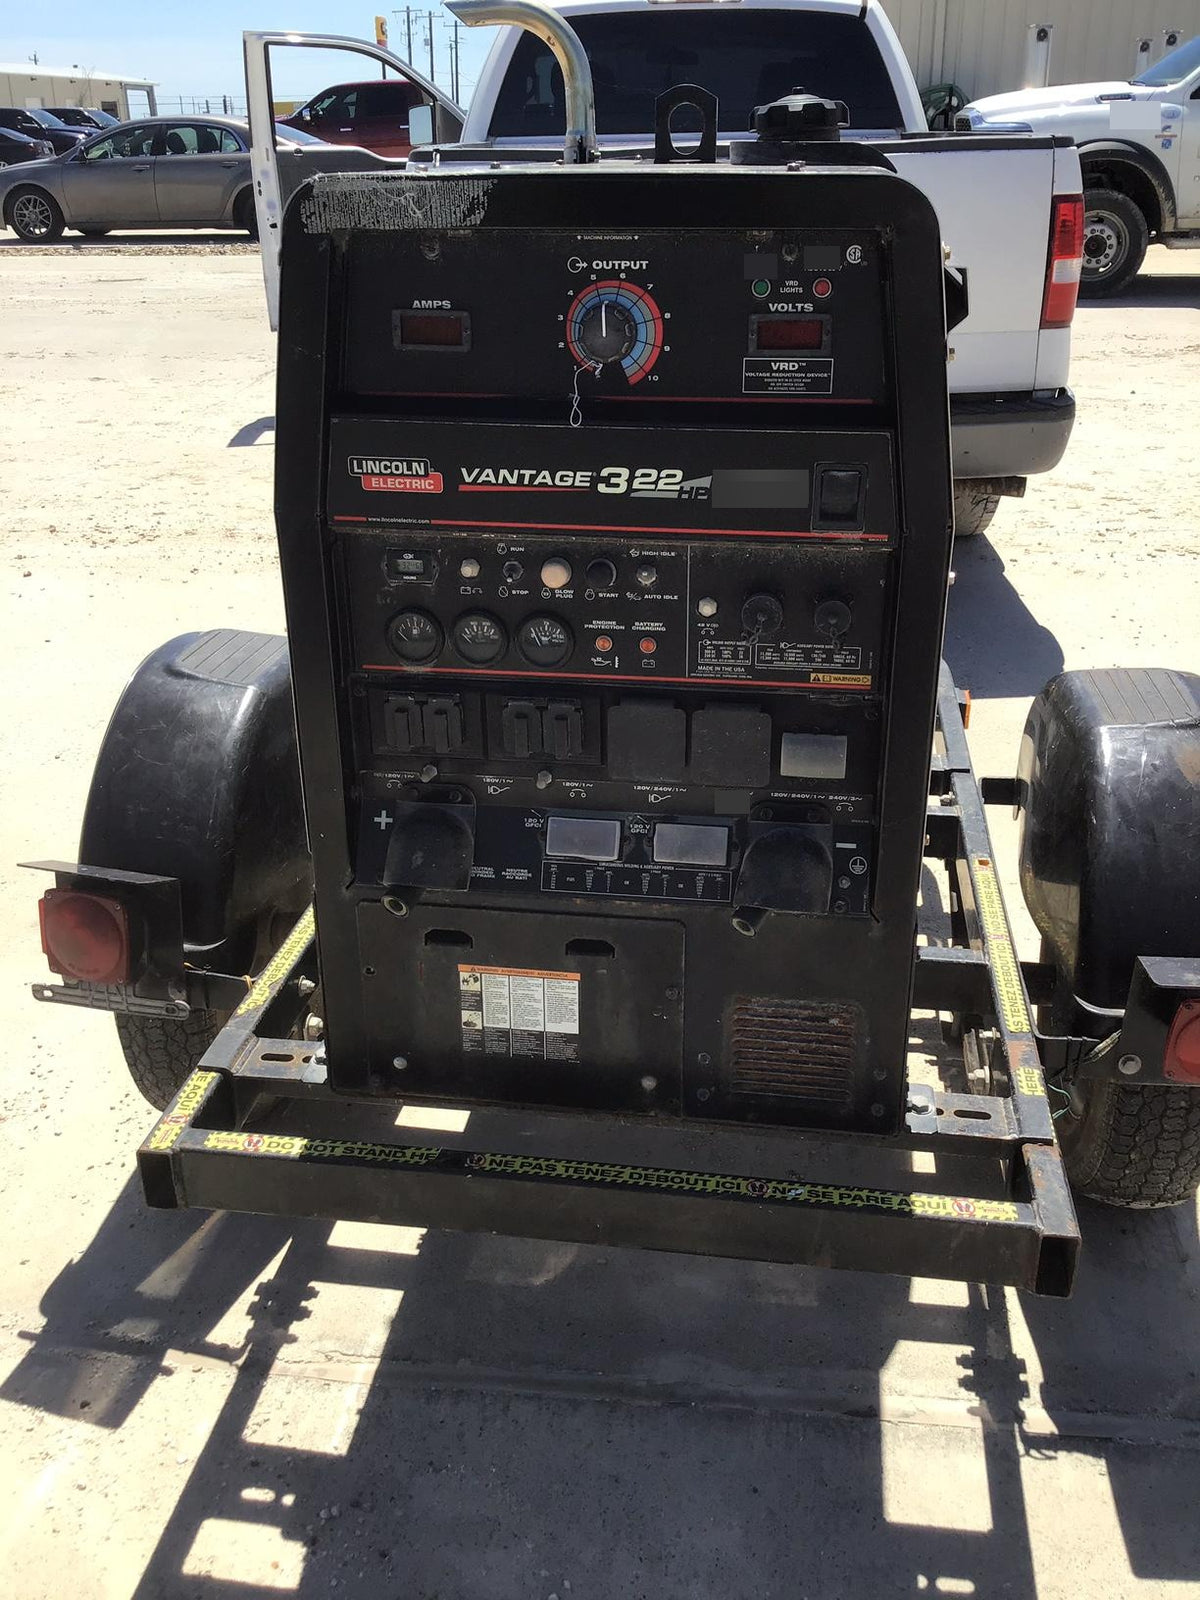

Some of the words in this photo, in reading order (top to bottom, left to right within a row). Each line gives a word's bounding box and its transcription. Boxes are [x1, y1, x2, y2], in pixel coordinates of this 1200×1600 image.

[592, 260, 649, 270] OUTPUT
[412, 299, 452, 310] AMPS
[768, 302, 814, 312] VOLTS
[647, 374, 660, 382] 10
[352, 460, 425, 476] LINCOLN
[371, 477, 434, 490] ELECTRIC
[460, 467, 592, 487] VANTAGE
[596, 466, 684, 495] 322
[996, 942, 1006, 952] ICI
[998, 954, 1014, 986] DEBOUT
[1006, 986, 1020, 1020] TENEZ
[1013, 1021, 1024, 1032] AS
[267, 1141, 294, 1150] DO
[302, 1142, 339, 1154] NOT
[343, 1145, 404, 1159] STAND
[488, 1158, 515, 1168] NE
[519, 1161, 558, 1172] PAS
[561, 1165, 624, 1179] TENEZ
[628, 1171, 712, 1188] DEBOUT
[715, 1180, 742, 1191] ICI
[807, 1189, 835, 1200] SE
[838, 1192, 894, 1206] PARE
